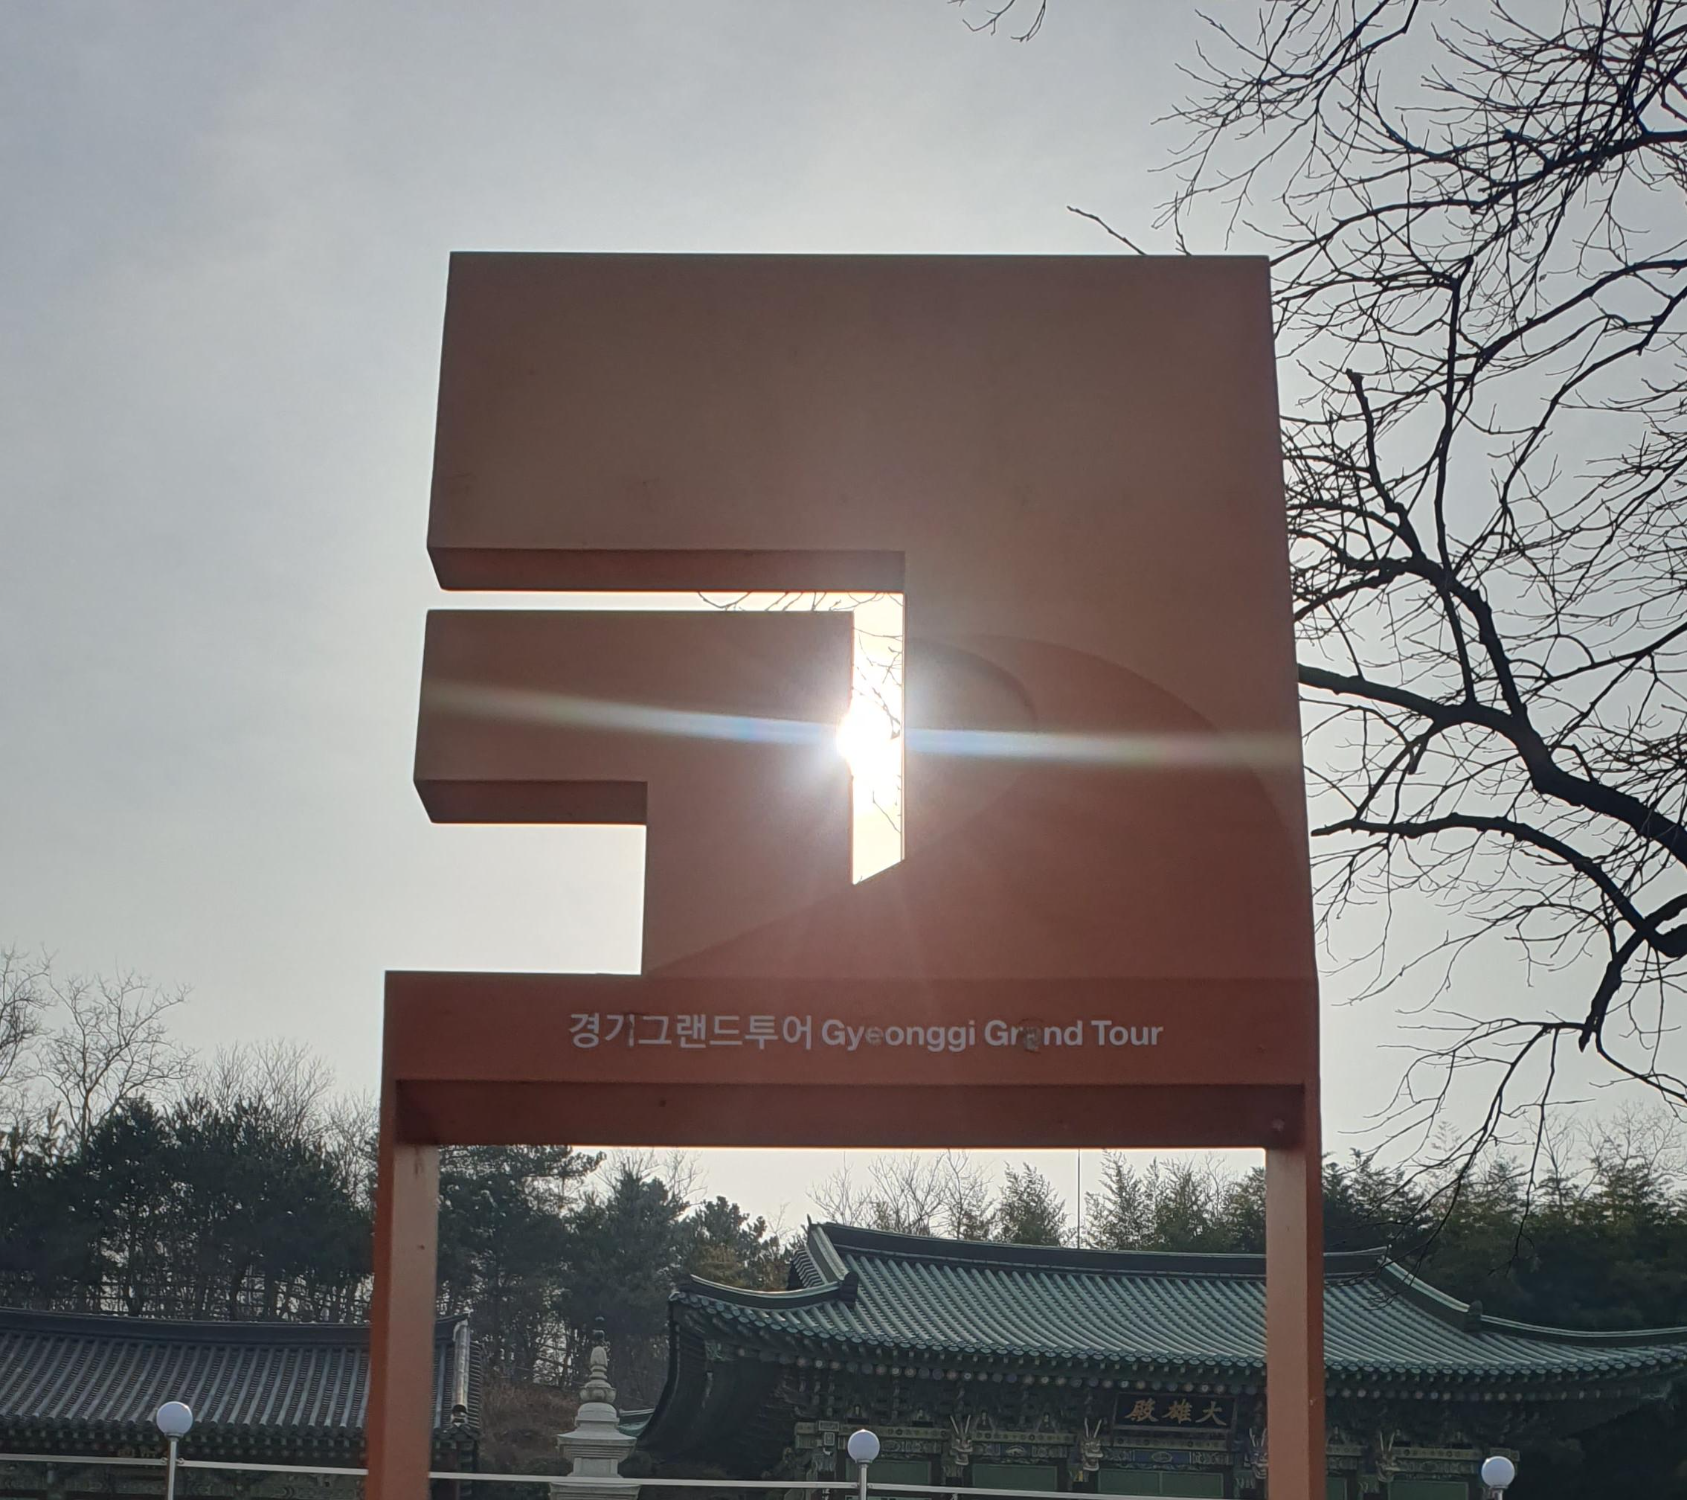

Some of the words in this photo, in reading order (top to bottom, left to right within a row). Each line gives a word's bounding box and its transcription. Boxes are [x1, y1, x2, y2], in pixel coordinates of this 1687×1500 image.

[568, 1012, 813, 1050] 경기그랜드투어
[821, 1018, 976, 1052] Gyeonggi
[1091, 1019, 1164, 1046] Tour
